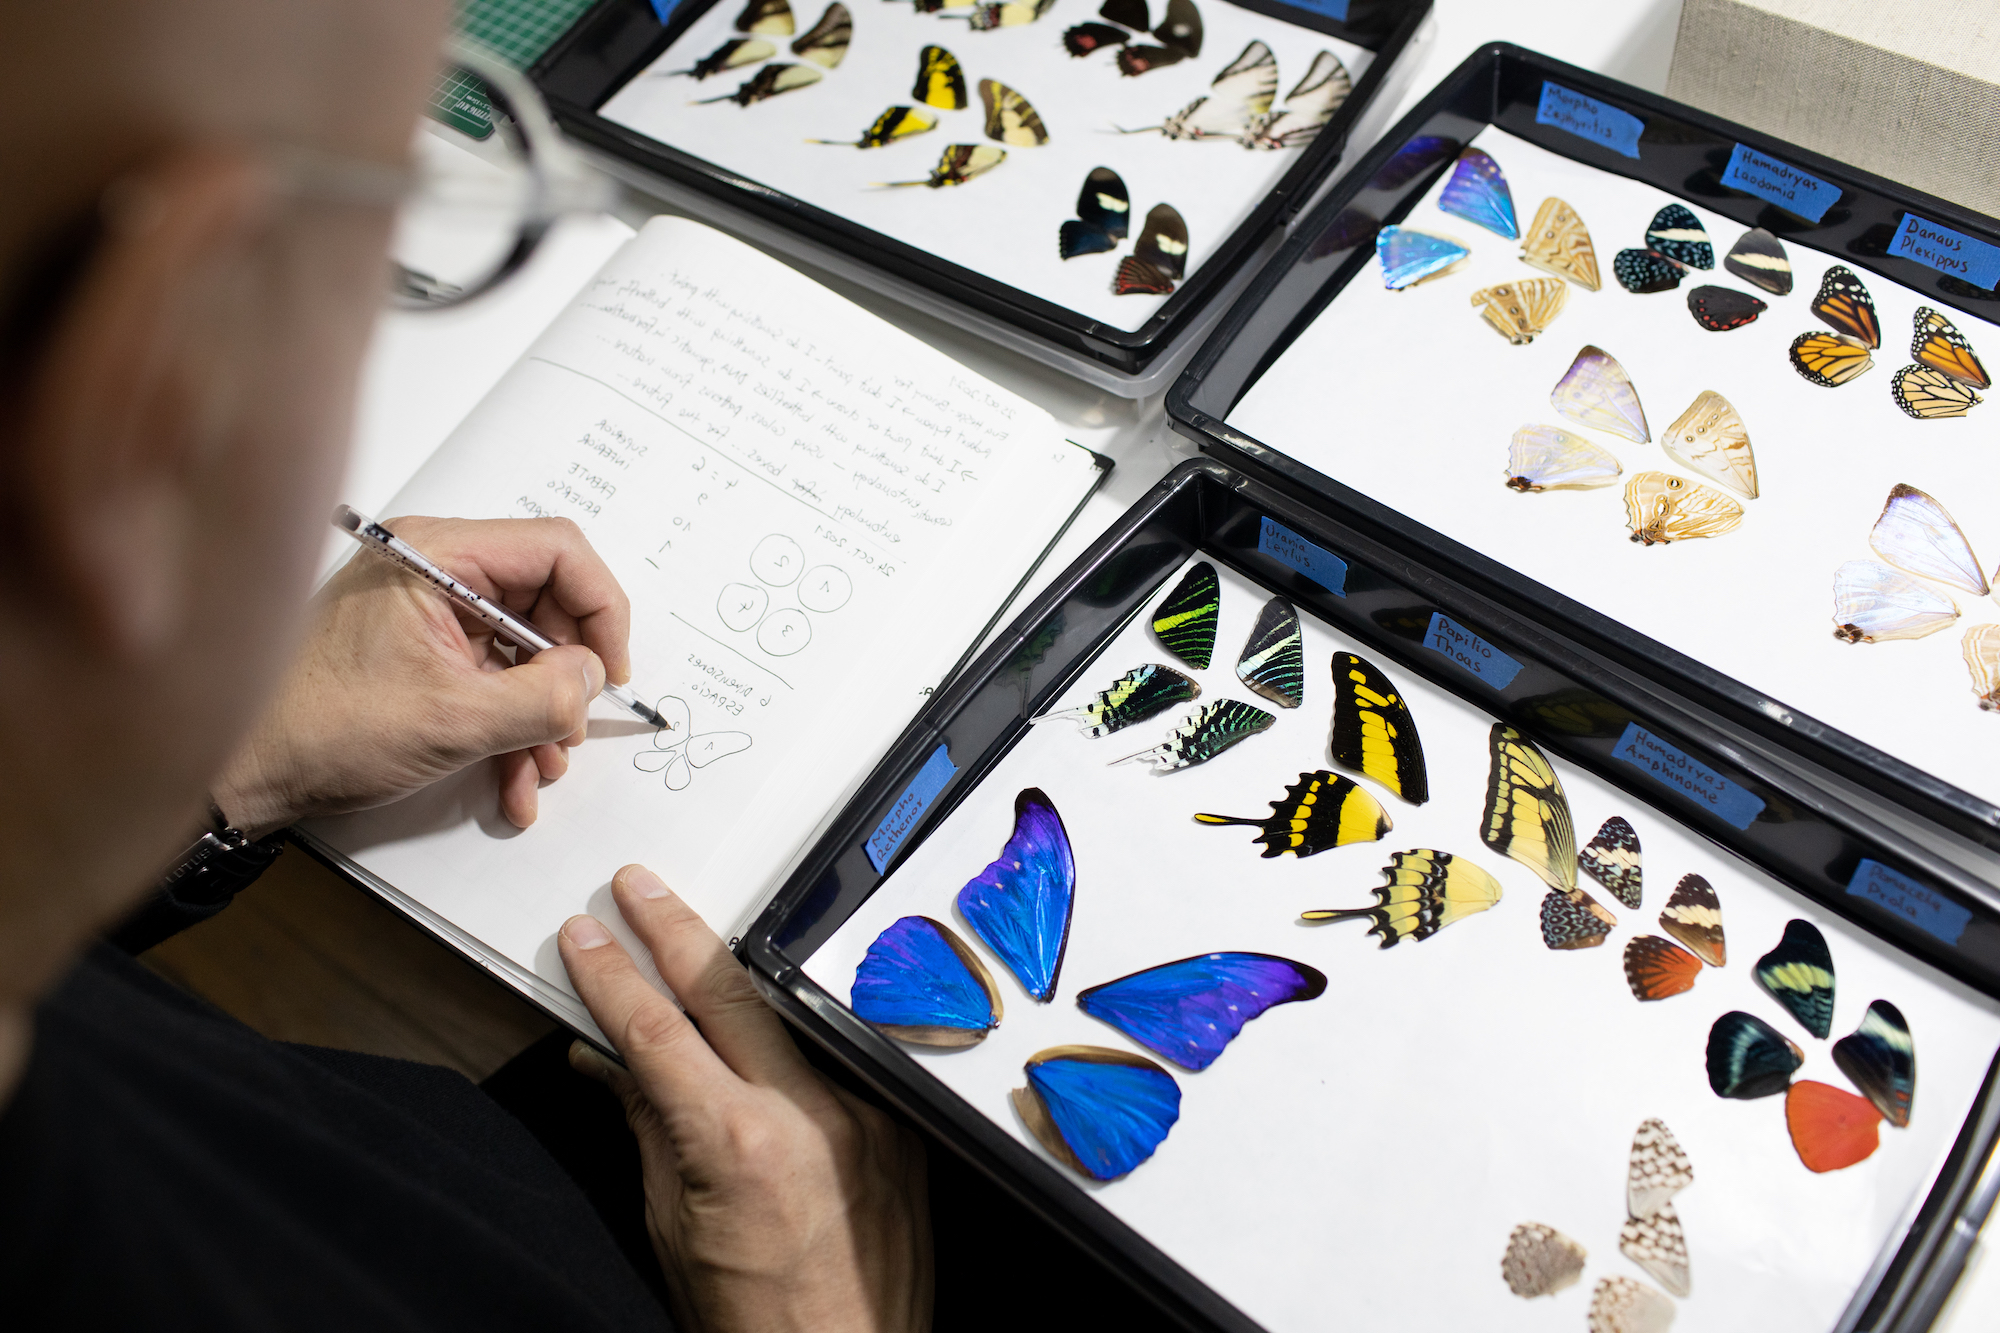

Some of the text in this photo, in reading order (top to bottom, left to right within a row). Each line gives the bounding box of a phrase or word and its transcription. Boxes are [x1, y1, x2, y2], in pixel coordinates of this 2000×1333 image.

[1733, 167, 1795, 201] Laodomia
[1742, 152, 1818, 191] Hamadryas
[1900, 235, 1968, 273] Plexippus
[1905, 219, 1962, 251] Danaus
[1265, 525, 1305, 552] Urania
[1433, 633, 1481, 673] Thoas
[1438, 618, 1496, 658] Papilio
[1625, 744, 1718, 804] Amphinome
[1635, 731, 1725, 790] Hamadryas
[872, 793, 914, 848] Morpho
[877, 797, 922, 862] Rethenor
[165, 847, 213, 884] LOTUS
